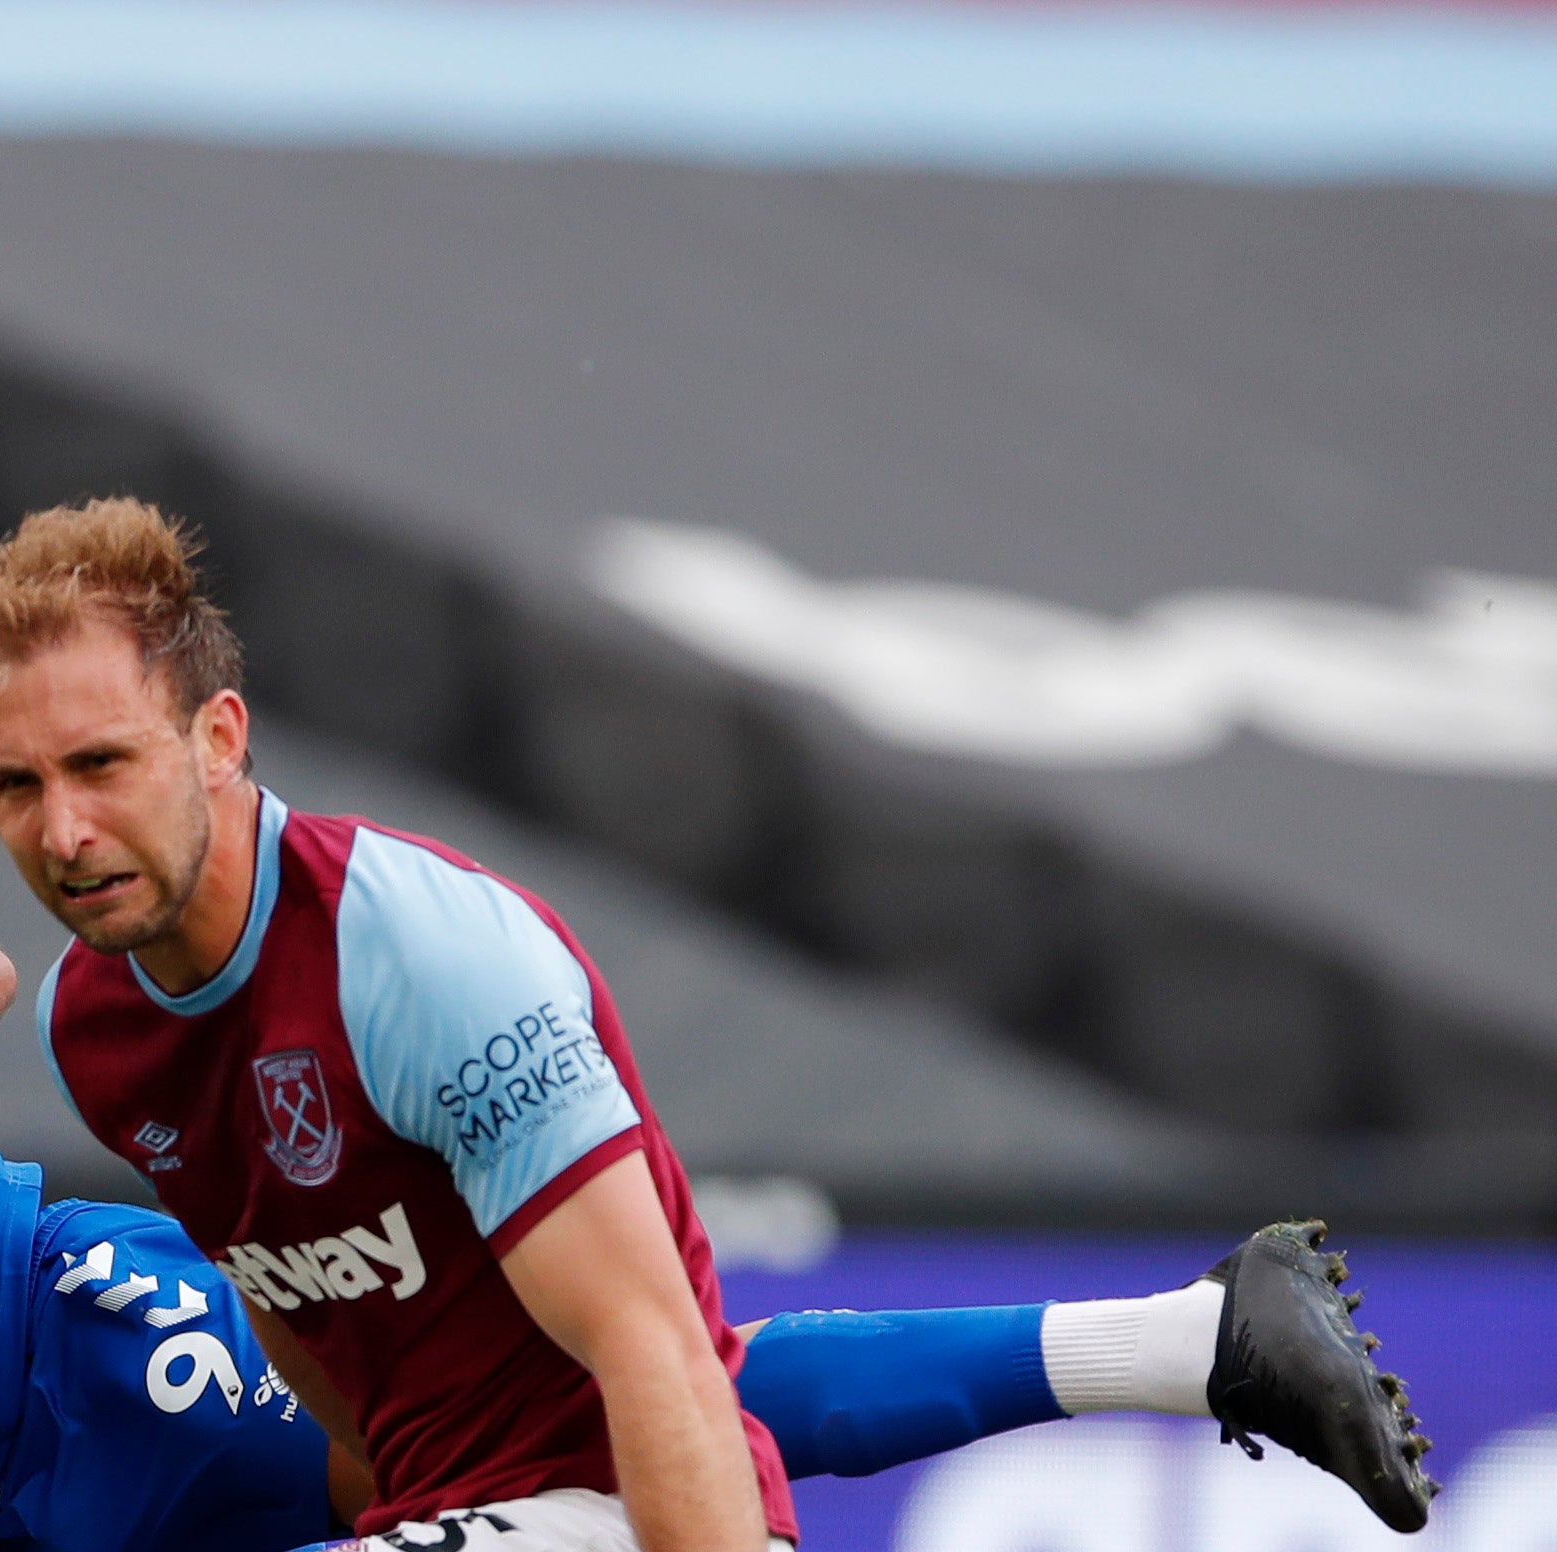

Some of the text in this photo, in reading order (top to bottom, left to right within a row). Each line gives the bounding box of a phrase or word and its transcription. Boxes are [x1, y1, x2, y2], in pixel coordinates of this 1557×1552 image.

[437, 1001, 566, 1118] SCOPE
[458, 1035, 607, 1157] MARKETS
[215, 1201, 427, 1313] etway
[145, 1330, 245, 1416] 9
